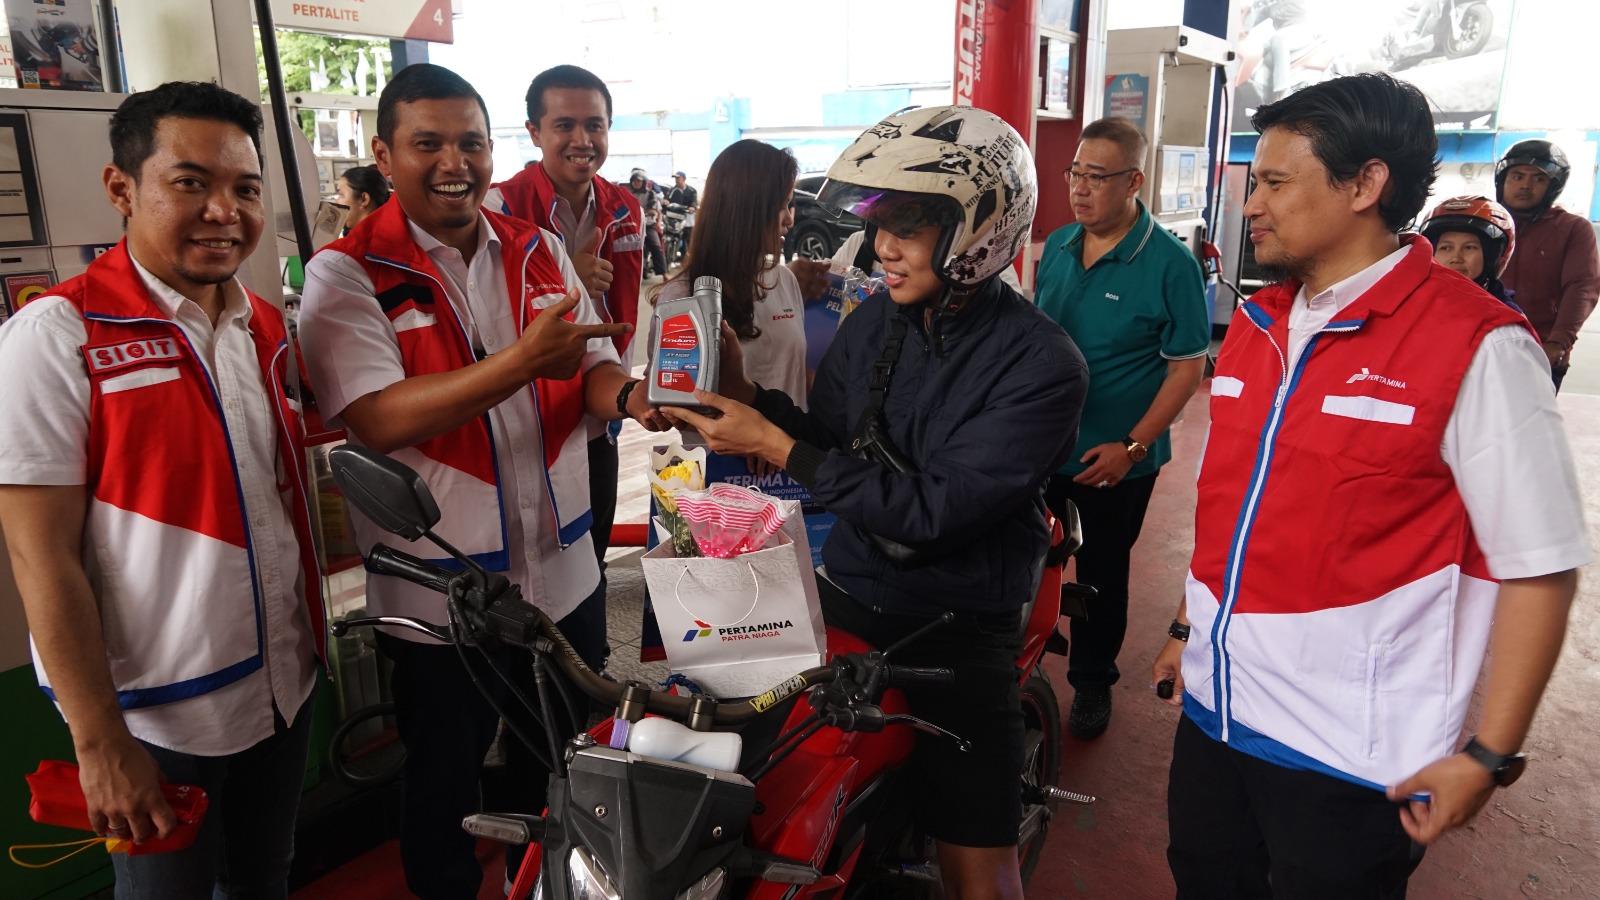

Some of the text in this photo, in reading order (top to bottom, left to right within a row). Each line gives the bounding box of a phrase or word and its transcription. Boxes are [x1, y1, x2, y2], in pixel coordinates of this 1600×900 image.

[292, 3, 359, 22] PERTALITE
[433, 8, 444, 26] 4
[970, 132, 1018, 190] FUTURE
[96, 340, 170, 366] SIGIT
[1367, 374, 1406, 390] PERTAMINA
[724, 472, 785, 488] TERIMA
[719, 620, 794, 636] PERTAMINA
[721, 630, 781, 642] PATRA NIAGA
